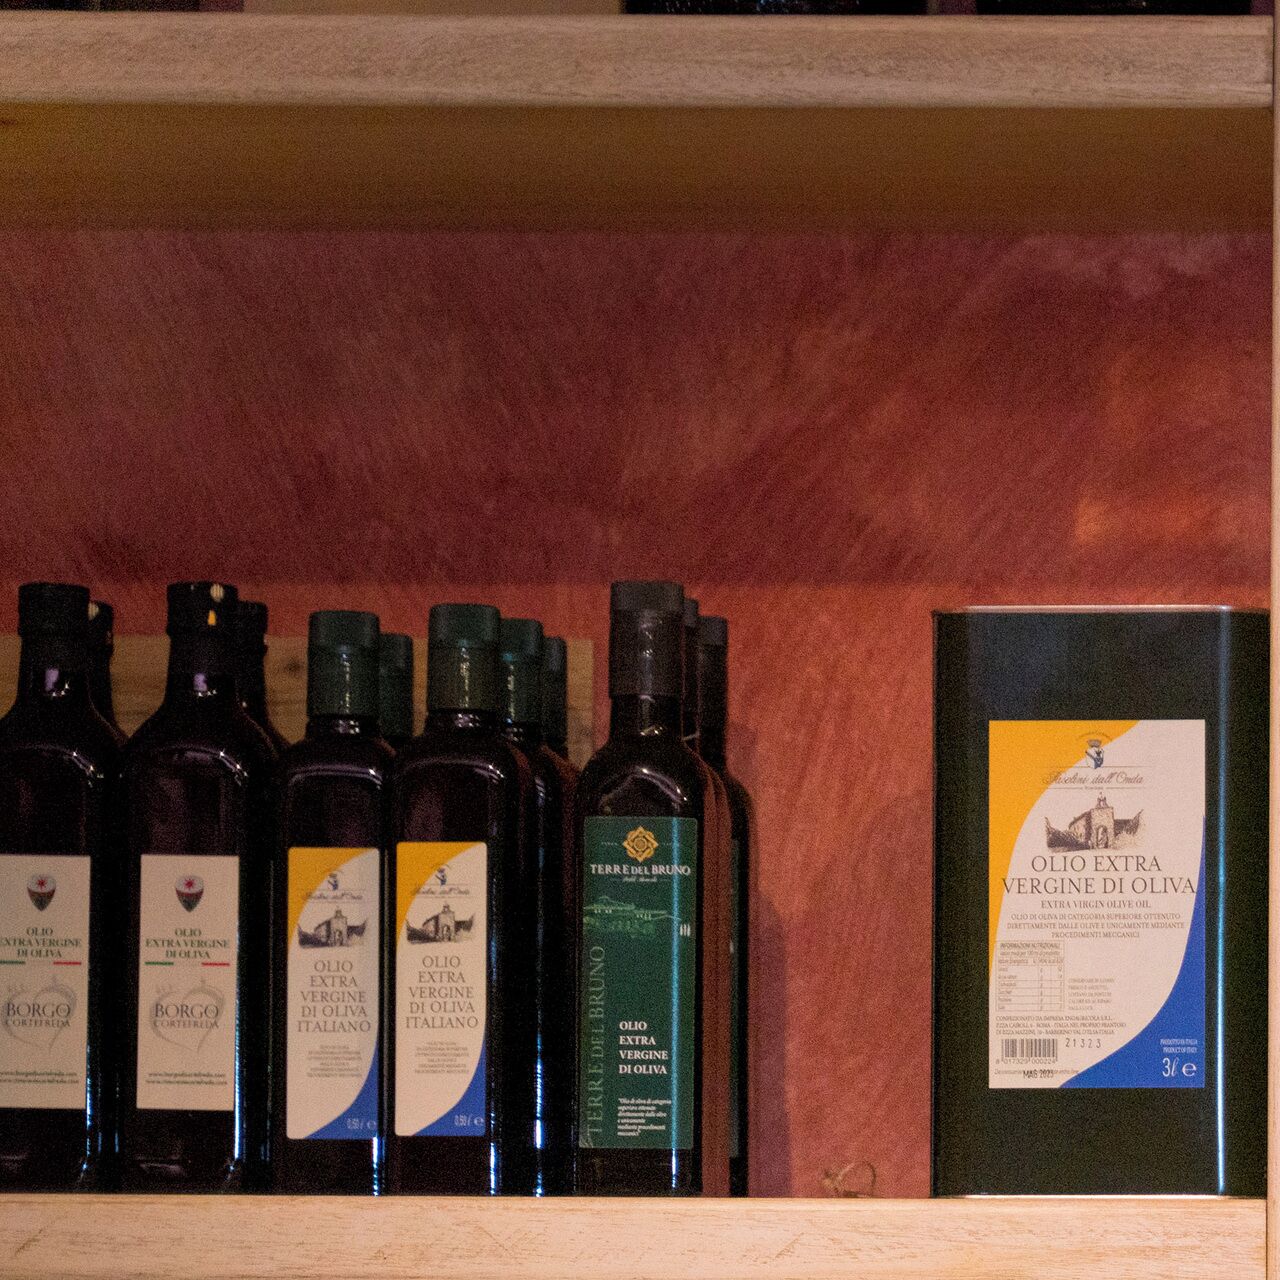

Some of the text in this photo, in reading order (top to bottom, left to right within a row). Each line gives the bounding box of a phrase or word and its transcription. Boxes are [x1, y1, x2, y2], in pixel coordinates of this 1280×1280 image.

[590, 863, 691, 876] TERRE DEL BRUNO
[1031, 855, 1163, 872] OLIO EXTRA
[1002, 877, 1197, 894] VERGINE DI OLIVA
[1041, 900, 1151, 908] EXTRA VIRGIN OLIVE OIL
[26, 927, 53, 937] OLIO
[174, 928, 202, 938] OLIO
[34, 938, 82, 948] VERGINE
[145, 939, 229, 949] EXTRA VERGINE
[17, 948, 62, 959] DI OLIVA
[165, 949, 211, 959] DI OLIVA
[314, 960, 353, 973] OLIO
[422, 955, 461, 968] OLIO
[310, 976, 358, 987] EXTRA
[418, 971, 466, 983] EXTRA
[300, 991, 366, 1003] VERGINE
[409, 986, 474, 999] VERGINE
[6, 1003, 71, 1018] BORGO
[155, 1003, 219, 1018] BORGO
[302, 1005, 368, 1017] DI OLIVA
[410, 1001, 475, 1014] DI OLIVA
[5, 1019, 71, 1028] CORTEFREDA
[153, 1020, 219, 1029] CORTEFREDA
[297, 1020, 371, 1032] ITALIANO
[405, 1016, 479, 1029] ITALIANO
[619, 1021, 648, 1031] OLIO
[586, 946, 606, 1135] TERRE DEL BRUNO
[619, 1035, 656, 1045] EXTRA
[619, 1050, 669, 1060] VERGINE
[619, 1065, 668, 1075] DI OLIVA
